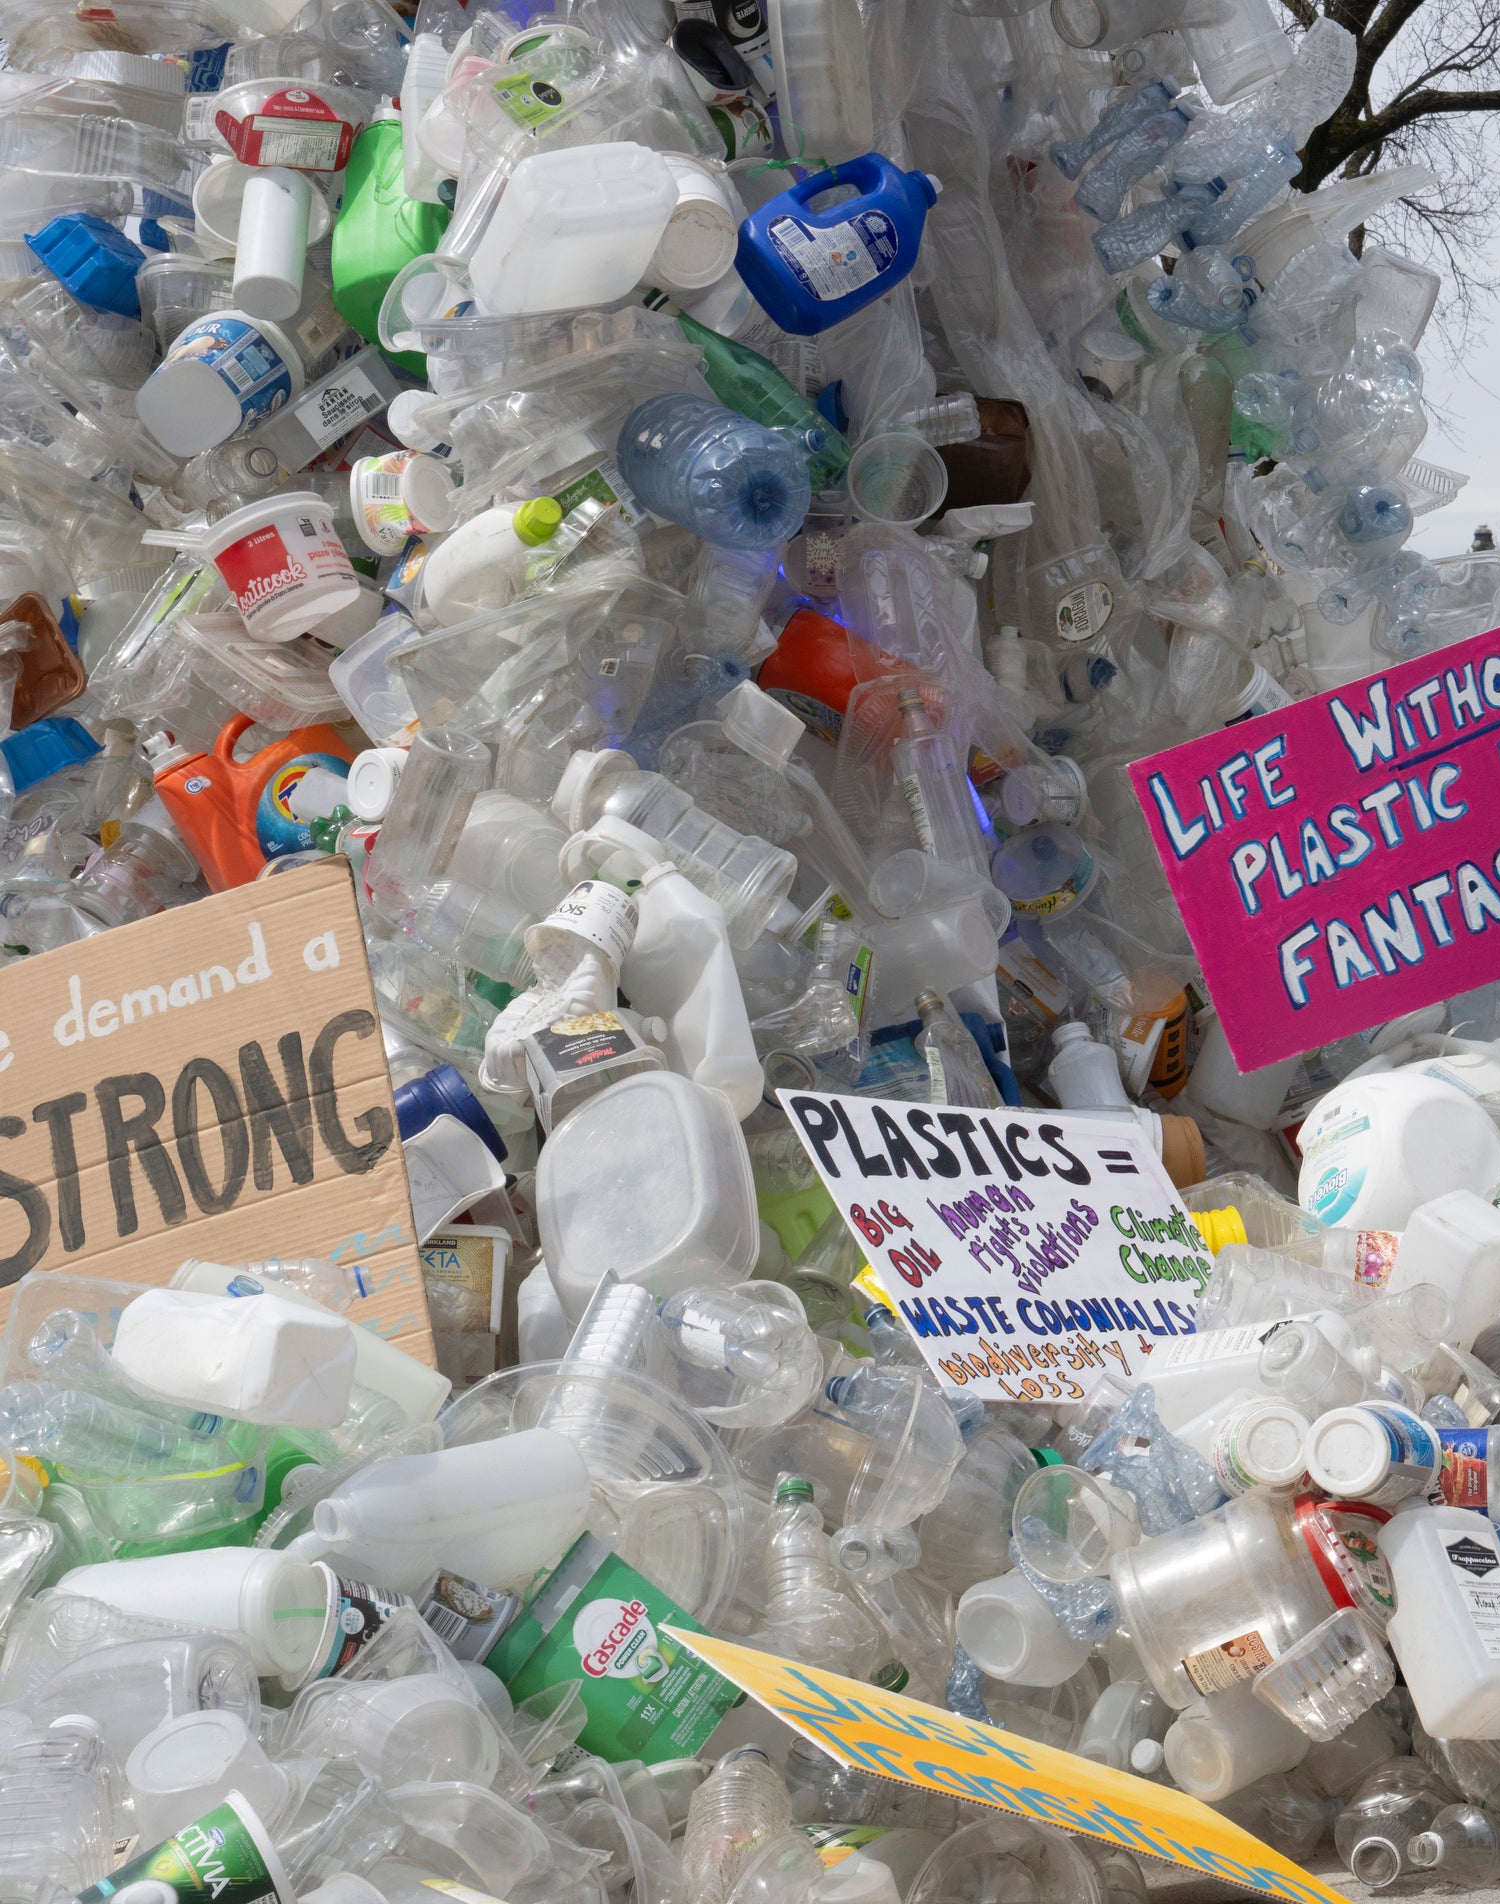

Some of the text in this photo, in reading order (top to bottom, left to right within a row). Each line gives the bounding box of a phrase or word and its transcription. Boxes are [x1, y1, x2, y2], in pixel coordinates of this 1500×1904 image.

[321, 393, 355, 419] Saucisses
[322, 413, 339, 428] dans
[346, 395, 364, 412] sirop
[254, 531, 276, 546] litres
[1147, 733, 1298, 862] LIFE
[1230, 762, 1468, 916] PLASTIC
[53, 921, 272, 1047] demand
[302, 929, 341, 974] a
[0, 1009, 395, 1289] STRONG
[790, 1095, 1092, 1186] PLASTICS
[850, 1199, 913, 1247] BIG
[927, 1184, 1035, 1242] human
[1109, 1204, 1211, 1252] Climate
[888, 1238, 942, 1288] OIL
[968, 1214, 1030, 1277] rights
[1018, 1198, 1099, 1295] violations
[1119, 1243, 1213, 1298] Change
[899, 1296, 1201, 1340] WASTE COLONIALIS
[938, 1336, 1133, 1387] biodiversity
[1451, 1553, 1498, 1566] Frappuccino
[582, 1600, 648, 1678] Cascade
[616, 1630, 648, 1669] POWER CLEAN
[776, 1666, 1036, 1771] Just
